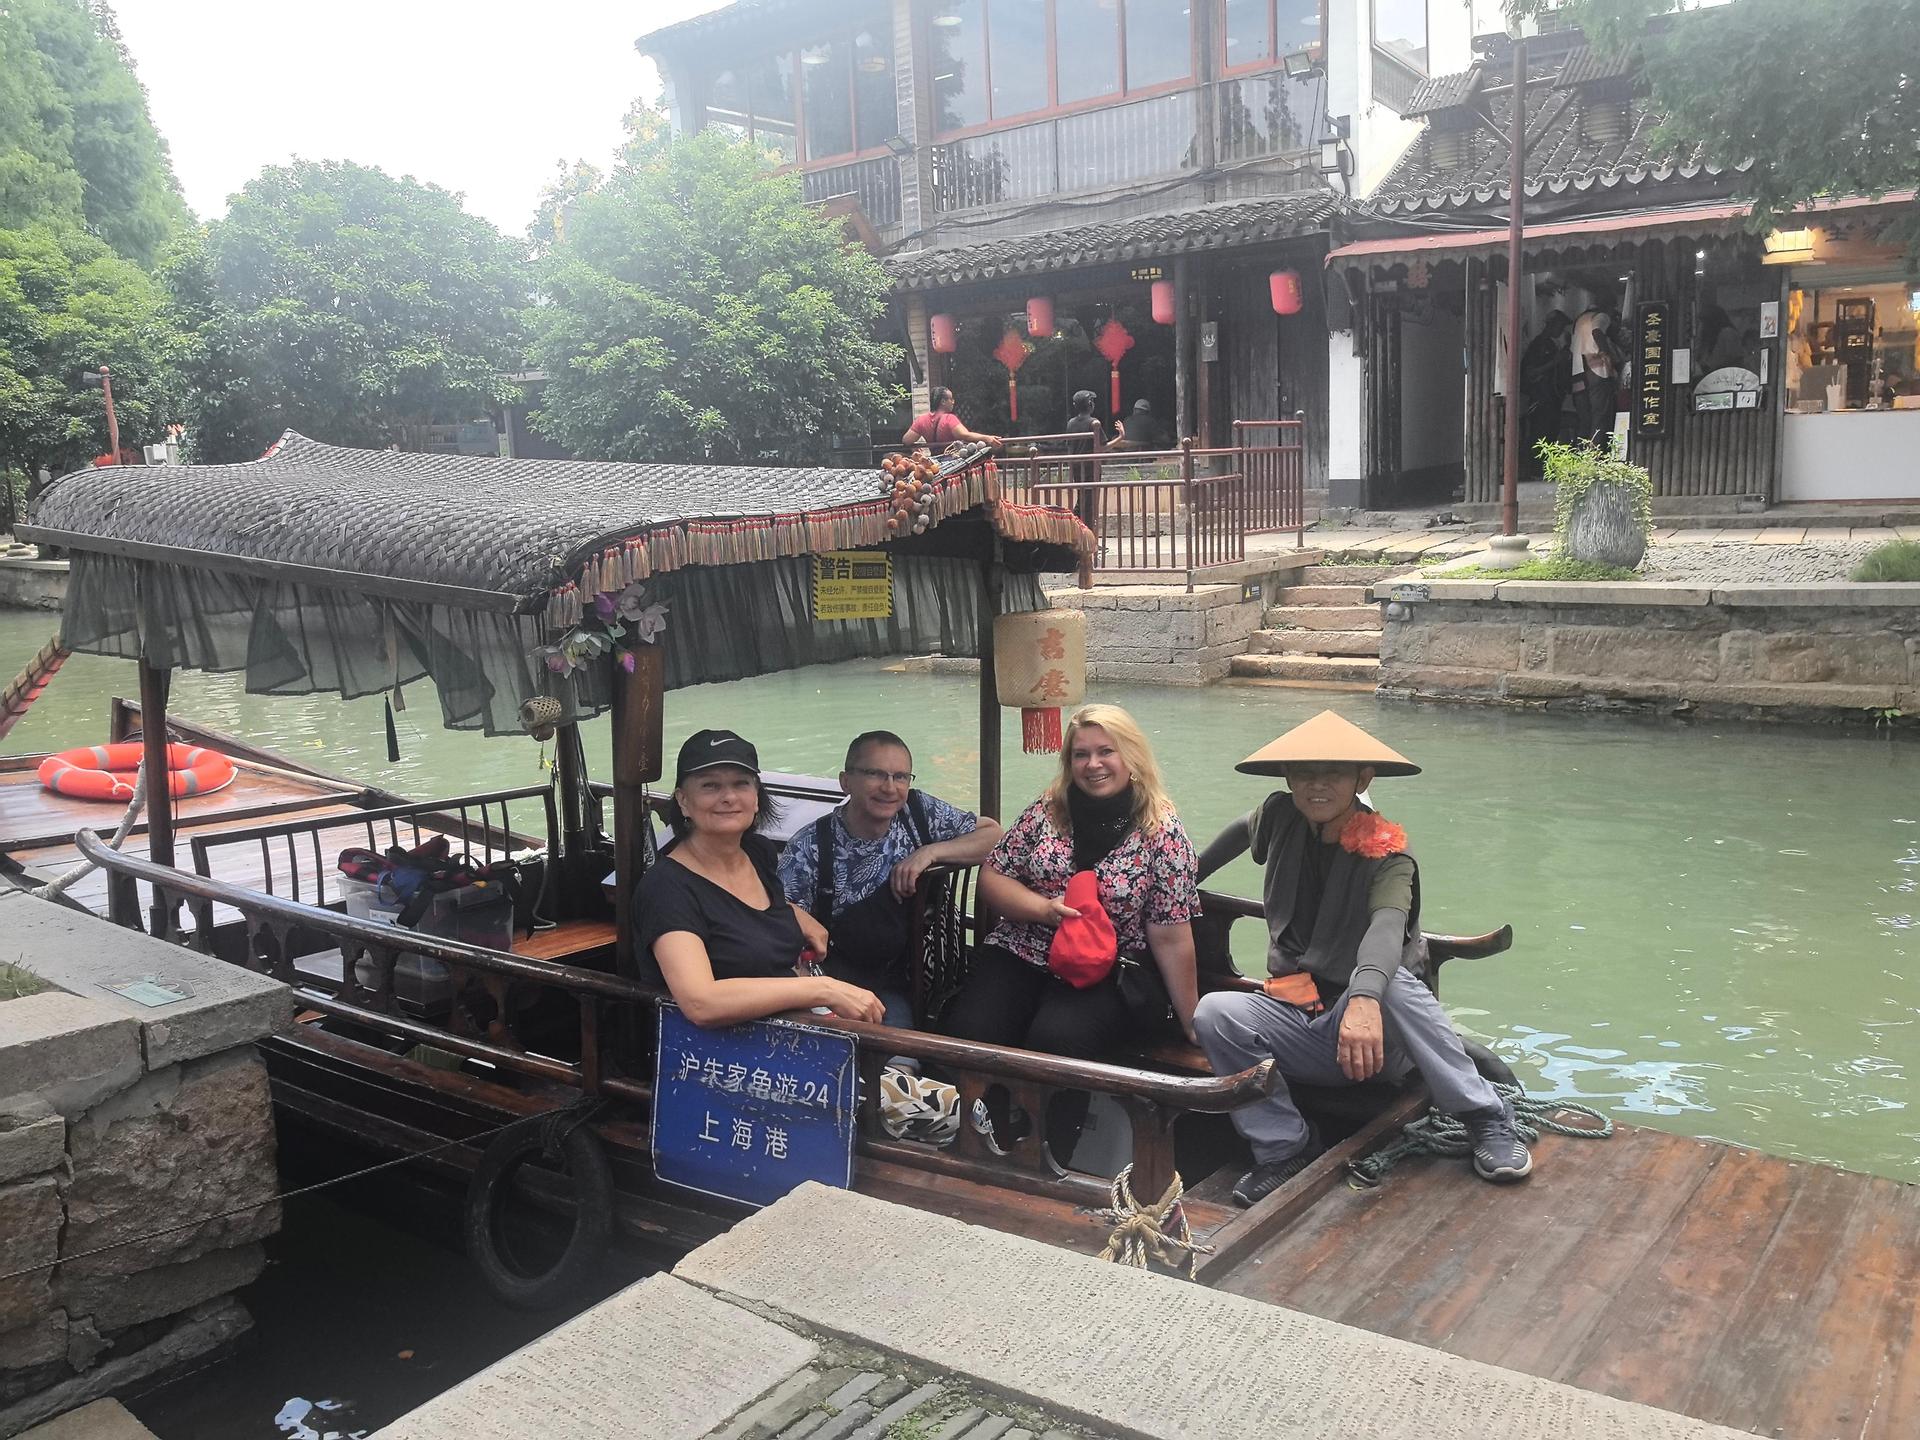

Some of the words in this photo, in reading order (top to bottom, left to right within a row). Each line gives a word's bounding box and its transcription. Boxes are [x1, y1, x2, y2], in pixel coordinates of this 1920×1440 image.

[820, 557, 851, 579] 警告
[699, 1110, 788, 1159] 上海港
